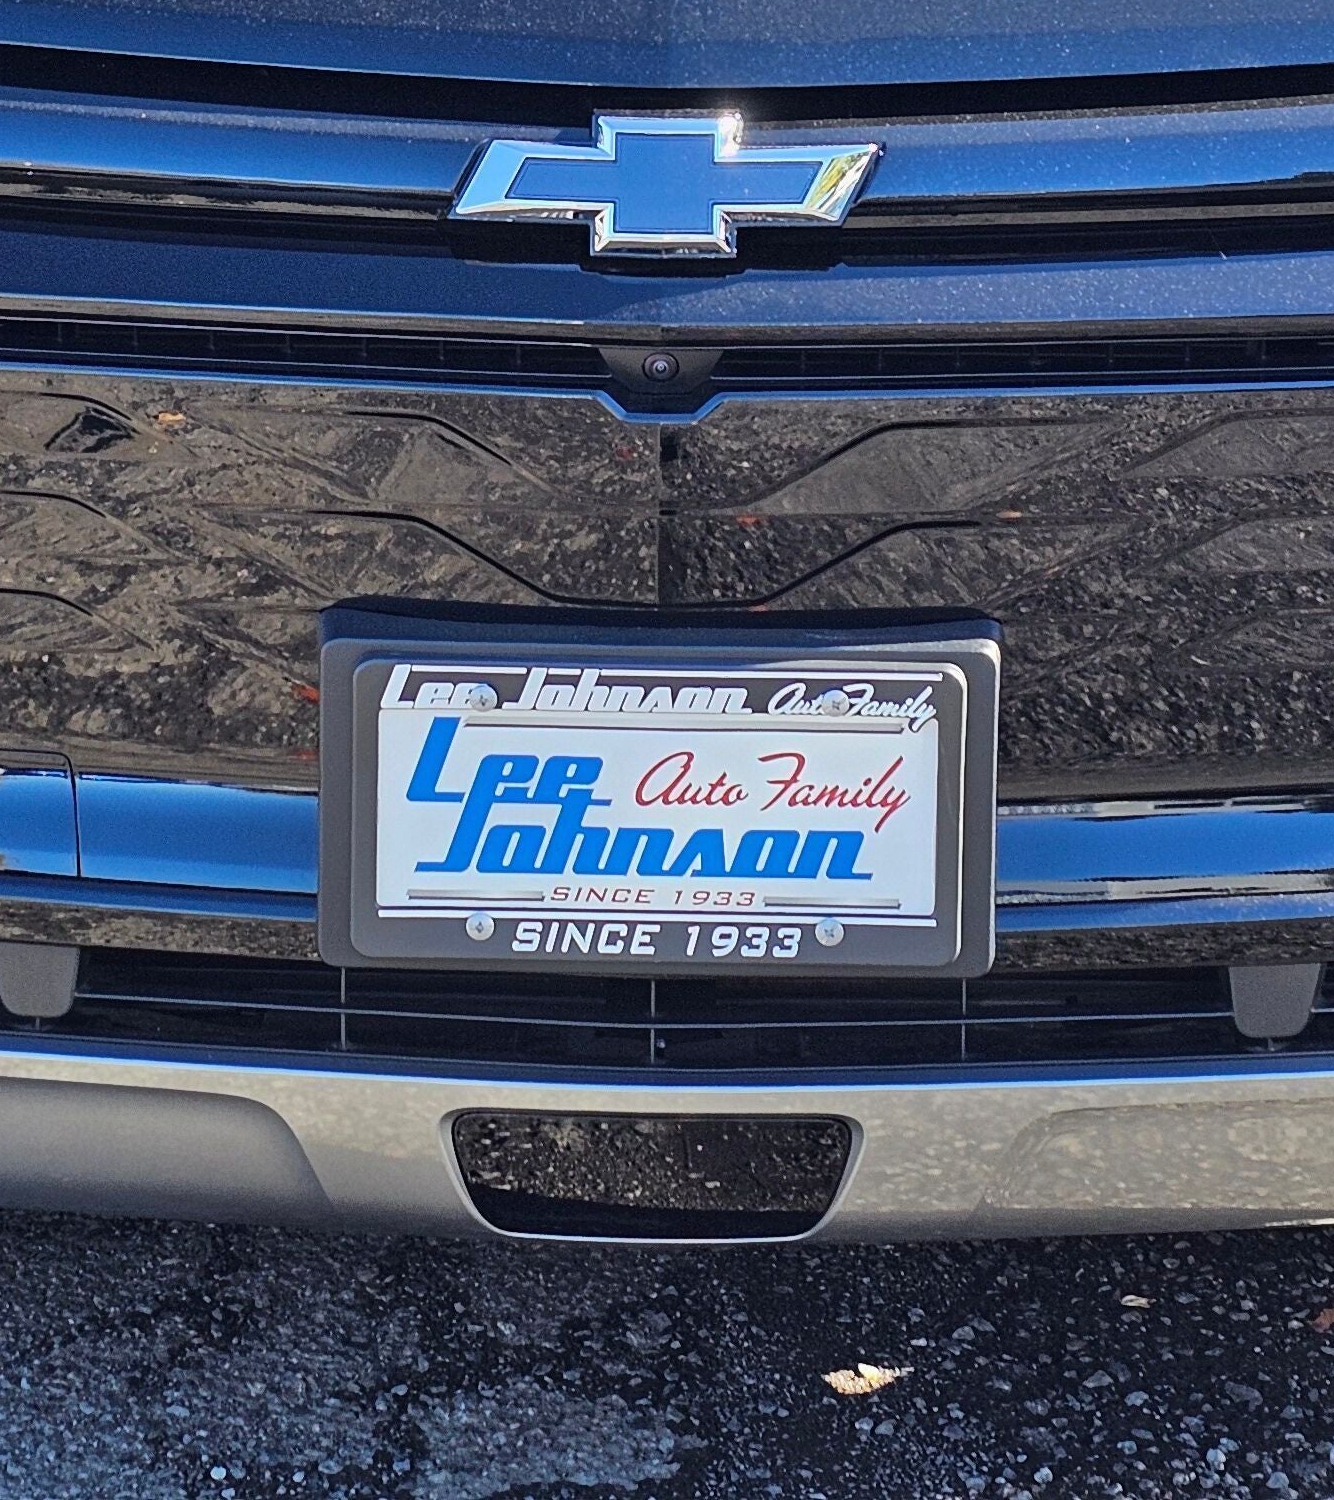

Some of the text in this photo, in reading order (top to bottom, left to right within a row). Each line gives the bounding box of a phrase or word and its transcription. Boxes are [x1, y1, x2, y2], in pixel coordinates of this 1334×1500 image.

[501, 667, 752, 714] Johnson
[843, 683, 937, 732] Family
[406, 716, 911, 833] Lee Auto Family
[415, 799, 873, 880] Johnson
[550, 886, 756, 907] SINCE 1933
[511, 921, 802, 959] SINCE 1933
